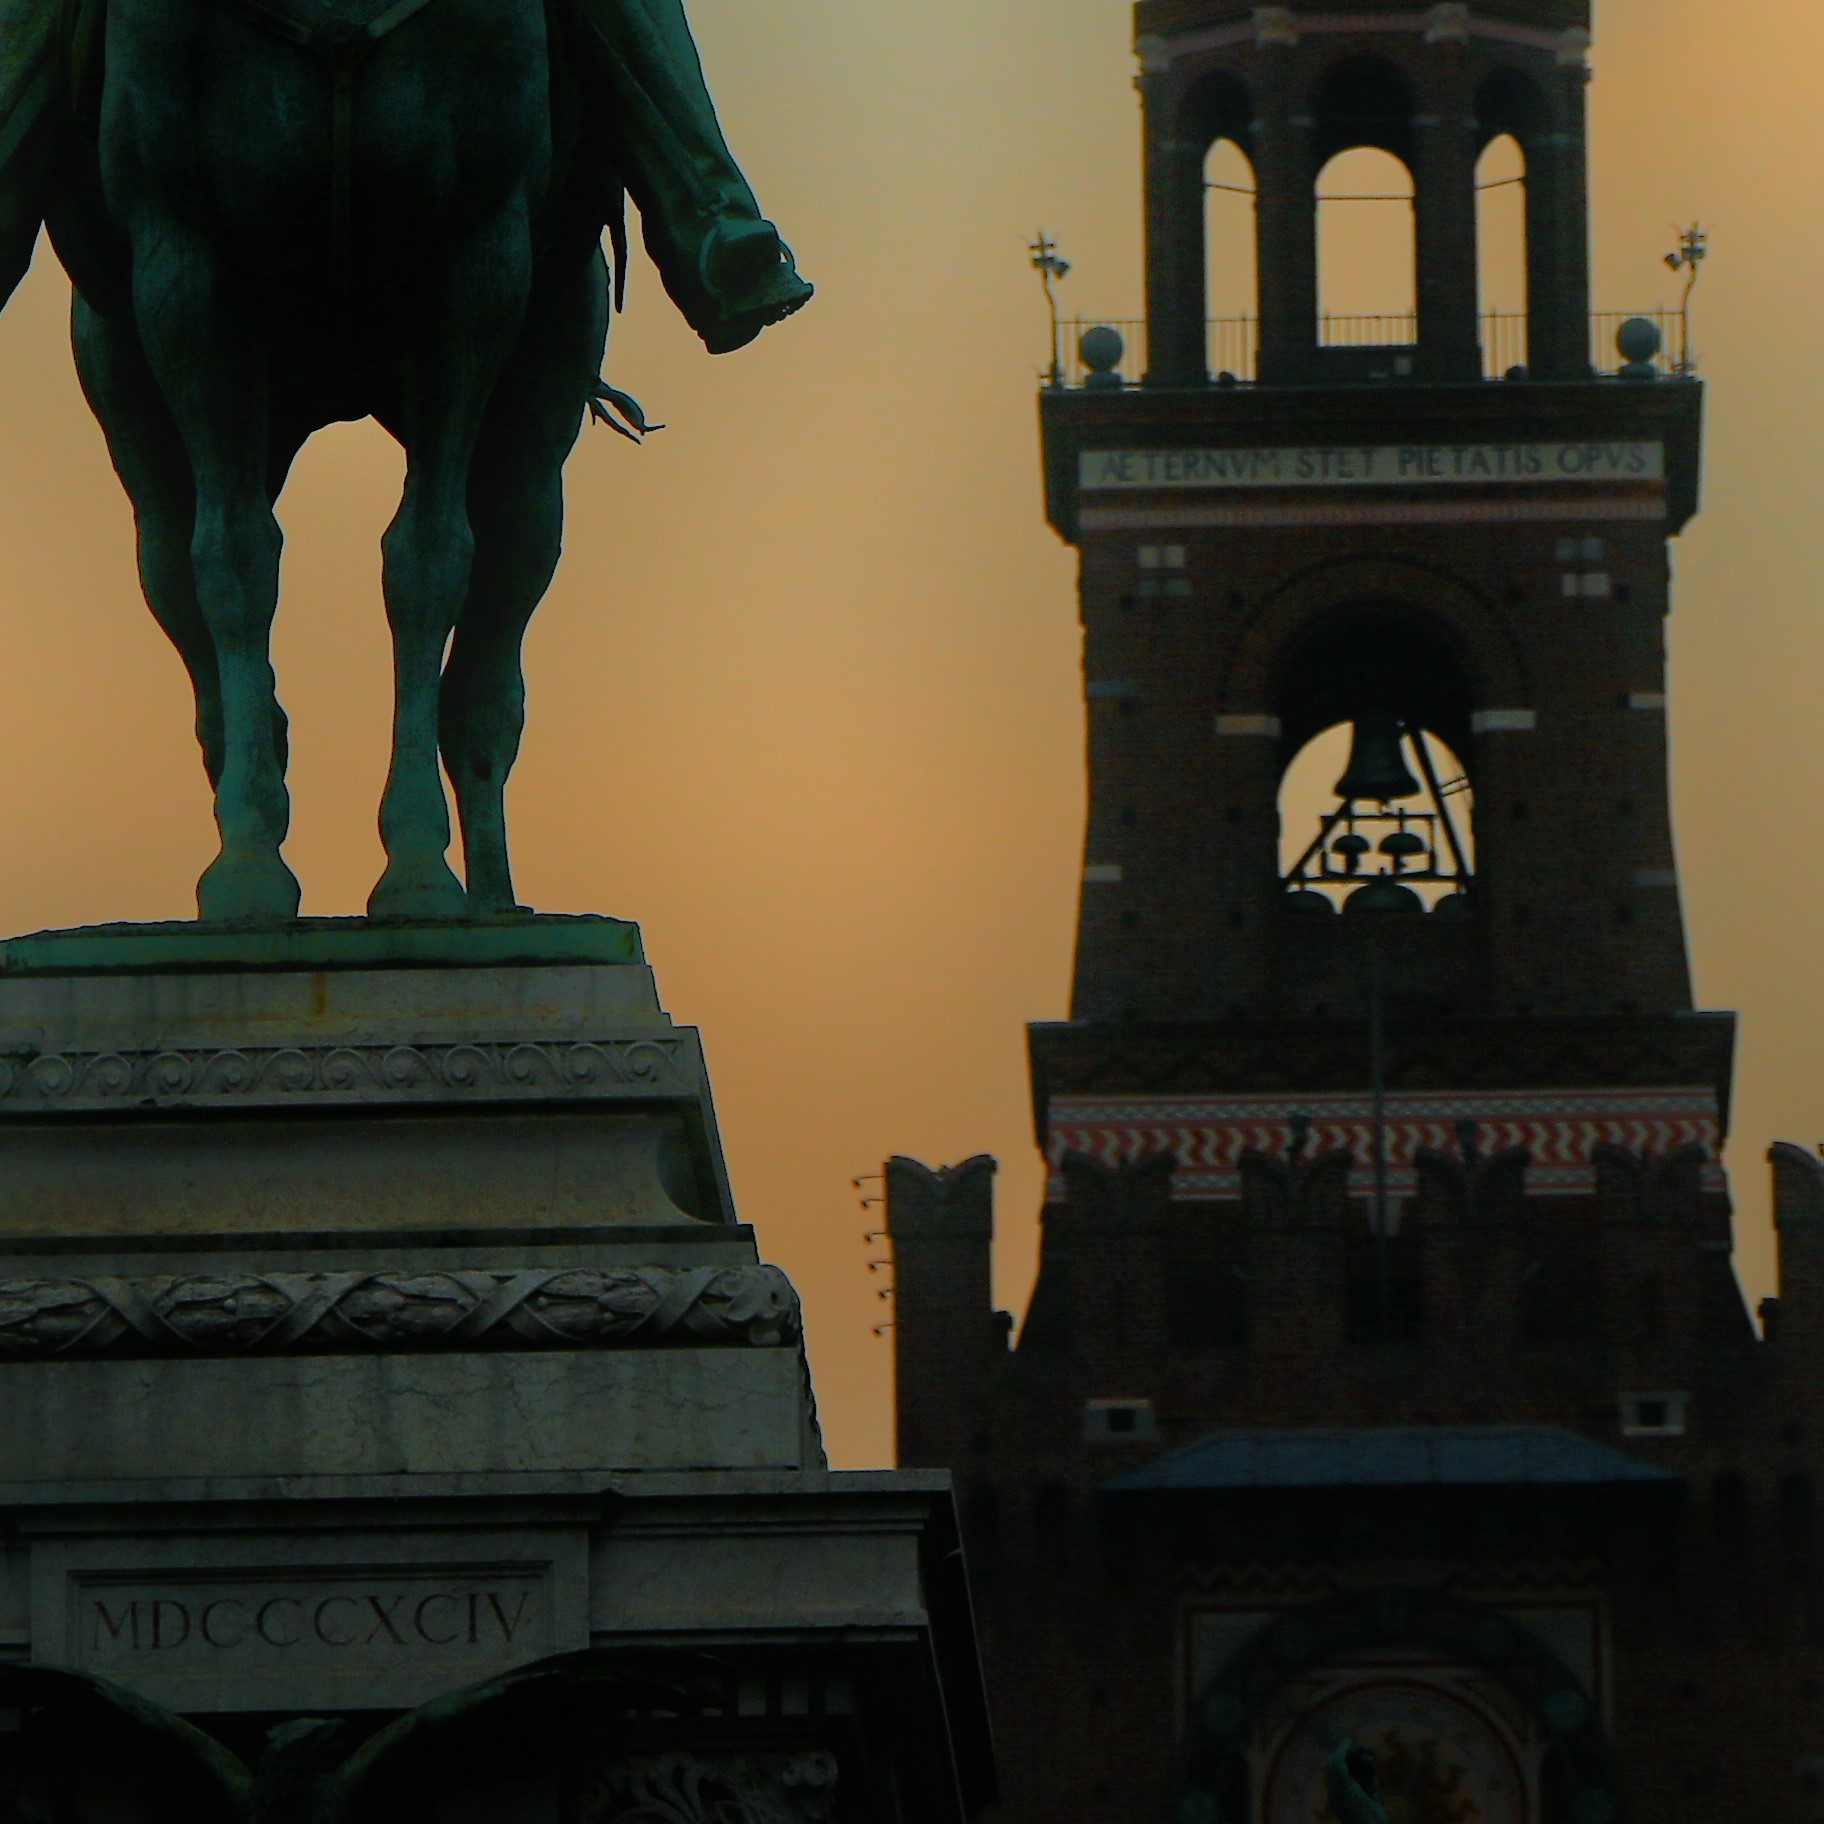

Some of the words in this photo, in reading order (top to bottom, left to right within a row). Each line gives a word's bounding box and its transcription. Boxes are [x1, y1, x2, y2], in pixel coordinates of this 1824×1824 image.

[1294, 447, 1377, 479] STET
[1397, 445, 1543, 476] PIETATIS
[1556, 443, 1647, 474] OPVS
[92, 1590, 532, 1652] MDCCCXCIV
